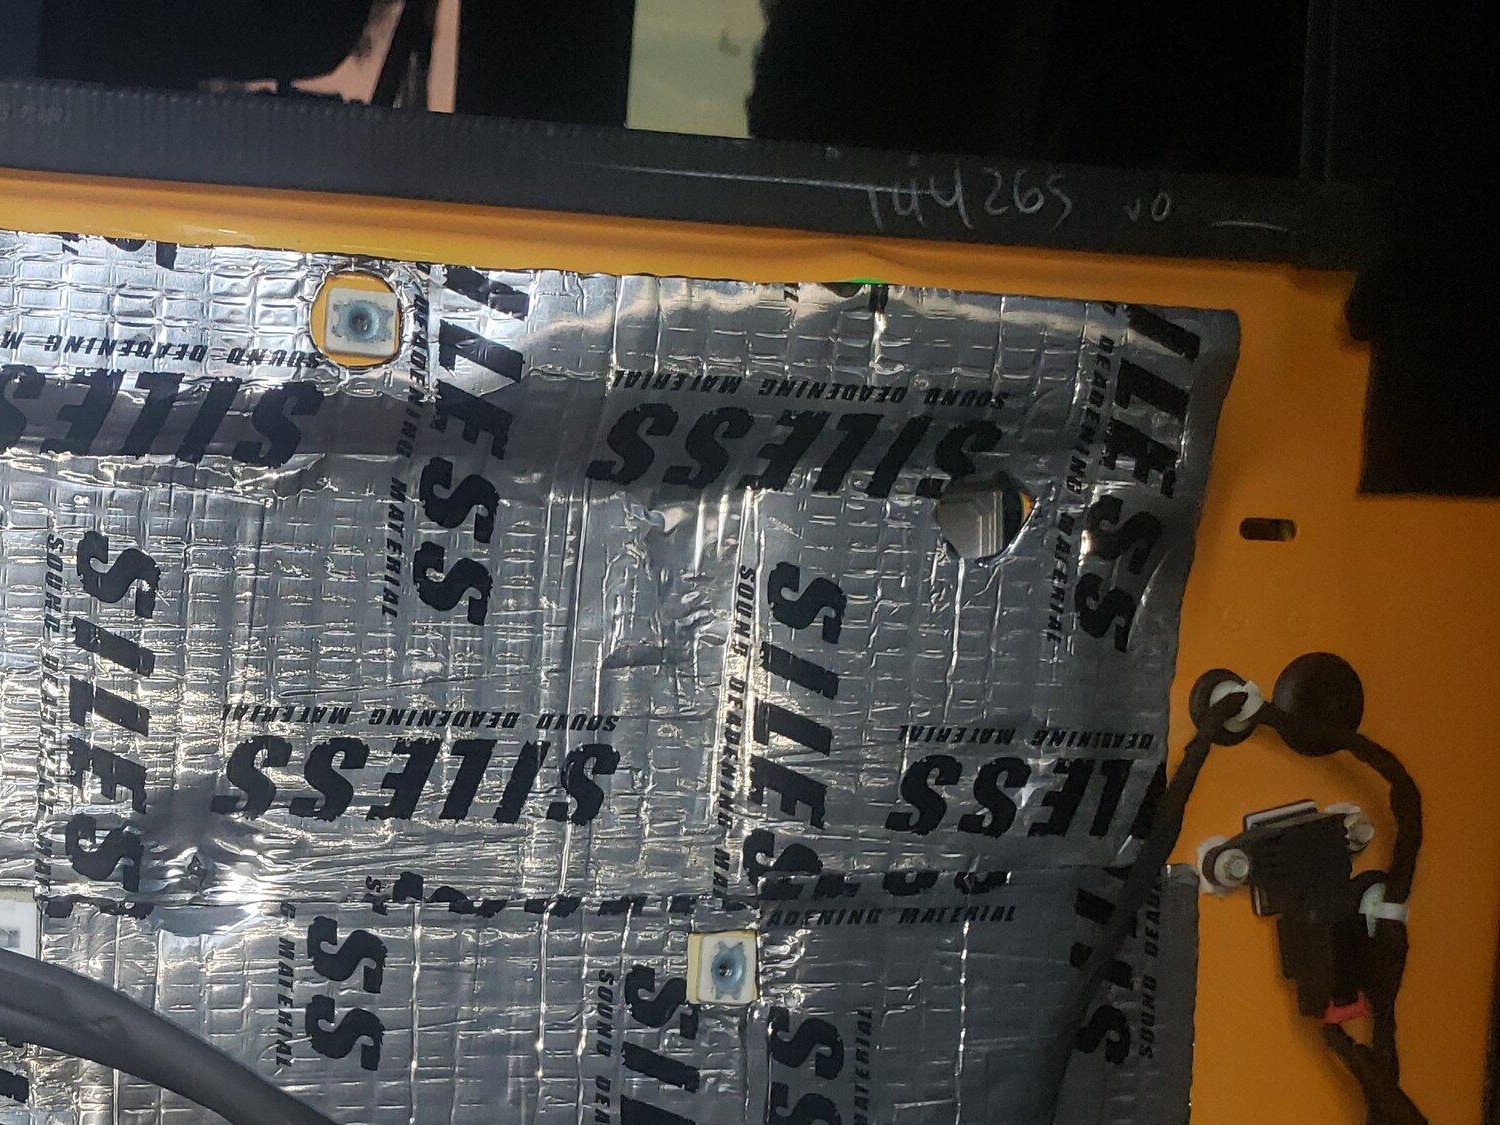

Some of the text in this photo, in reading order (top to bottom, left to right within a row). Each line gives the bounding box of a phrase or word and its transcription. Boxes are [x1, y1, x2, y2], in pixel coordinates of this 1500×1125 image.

[45, 334, 203, 363] DEADENING
[227, 347, 320, 369] SOUND
[613, 370, 1009, 409] SOUND DEADENING MATERIAL
[382, 294, 430, 620] DEADENING MATERIAL
[1045, 335, 1115, 645] DEADENING MATERIAL
[45, 534, 65, 635] SOUND
[729, 564, 755, 656] SOUND
[222, 703, 620, 732] SOUND DEADENING MATERIAL
[718, 677, 750, 830] DEADENING
[898, 724, 1155, 750] DEADENING MATERIAL
[212, 735, 621, 826] SILESS
[898, 904, 1016, 925] MATERIAL
[276, 937, 296, 1069] MATERIAL
[595, 969, 616, 1057] SOUND
